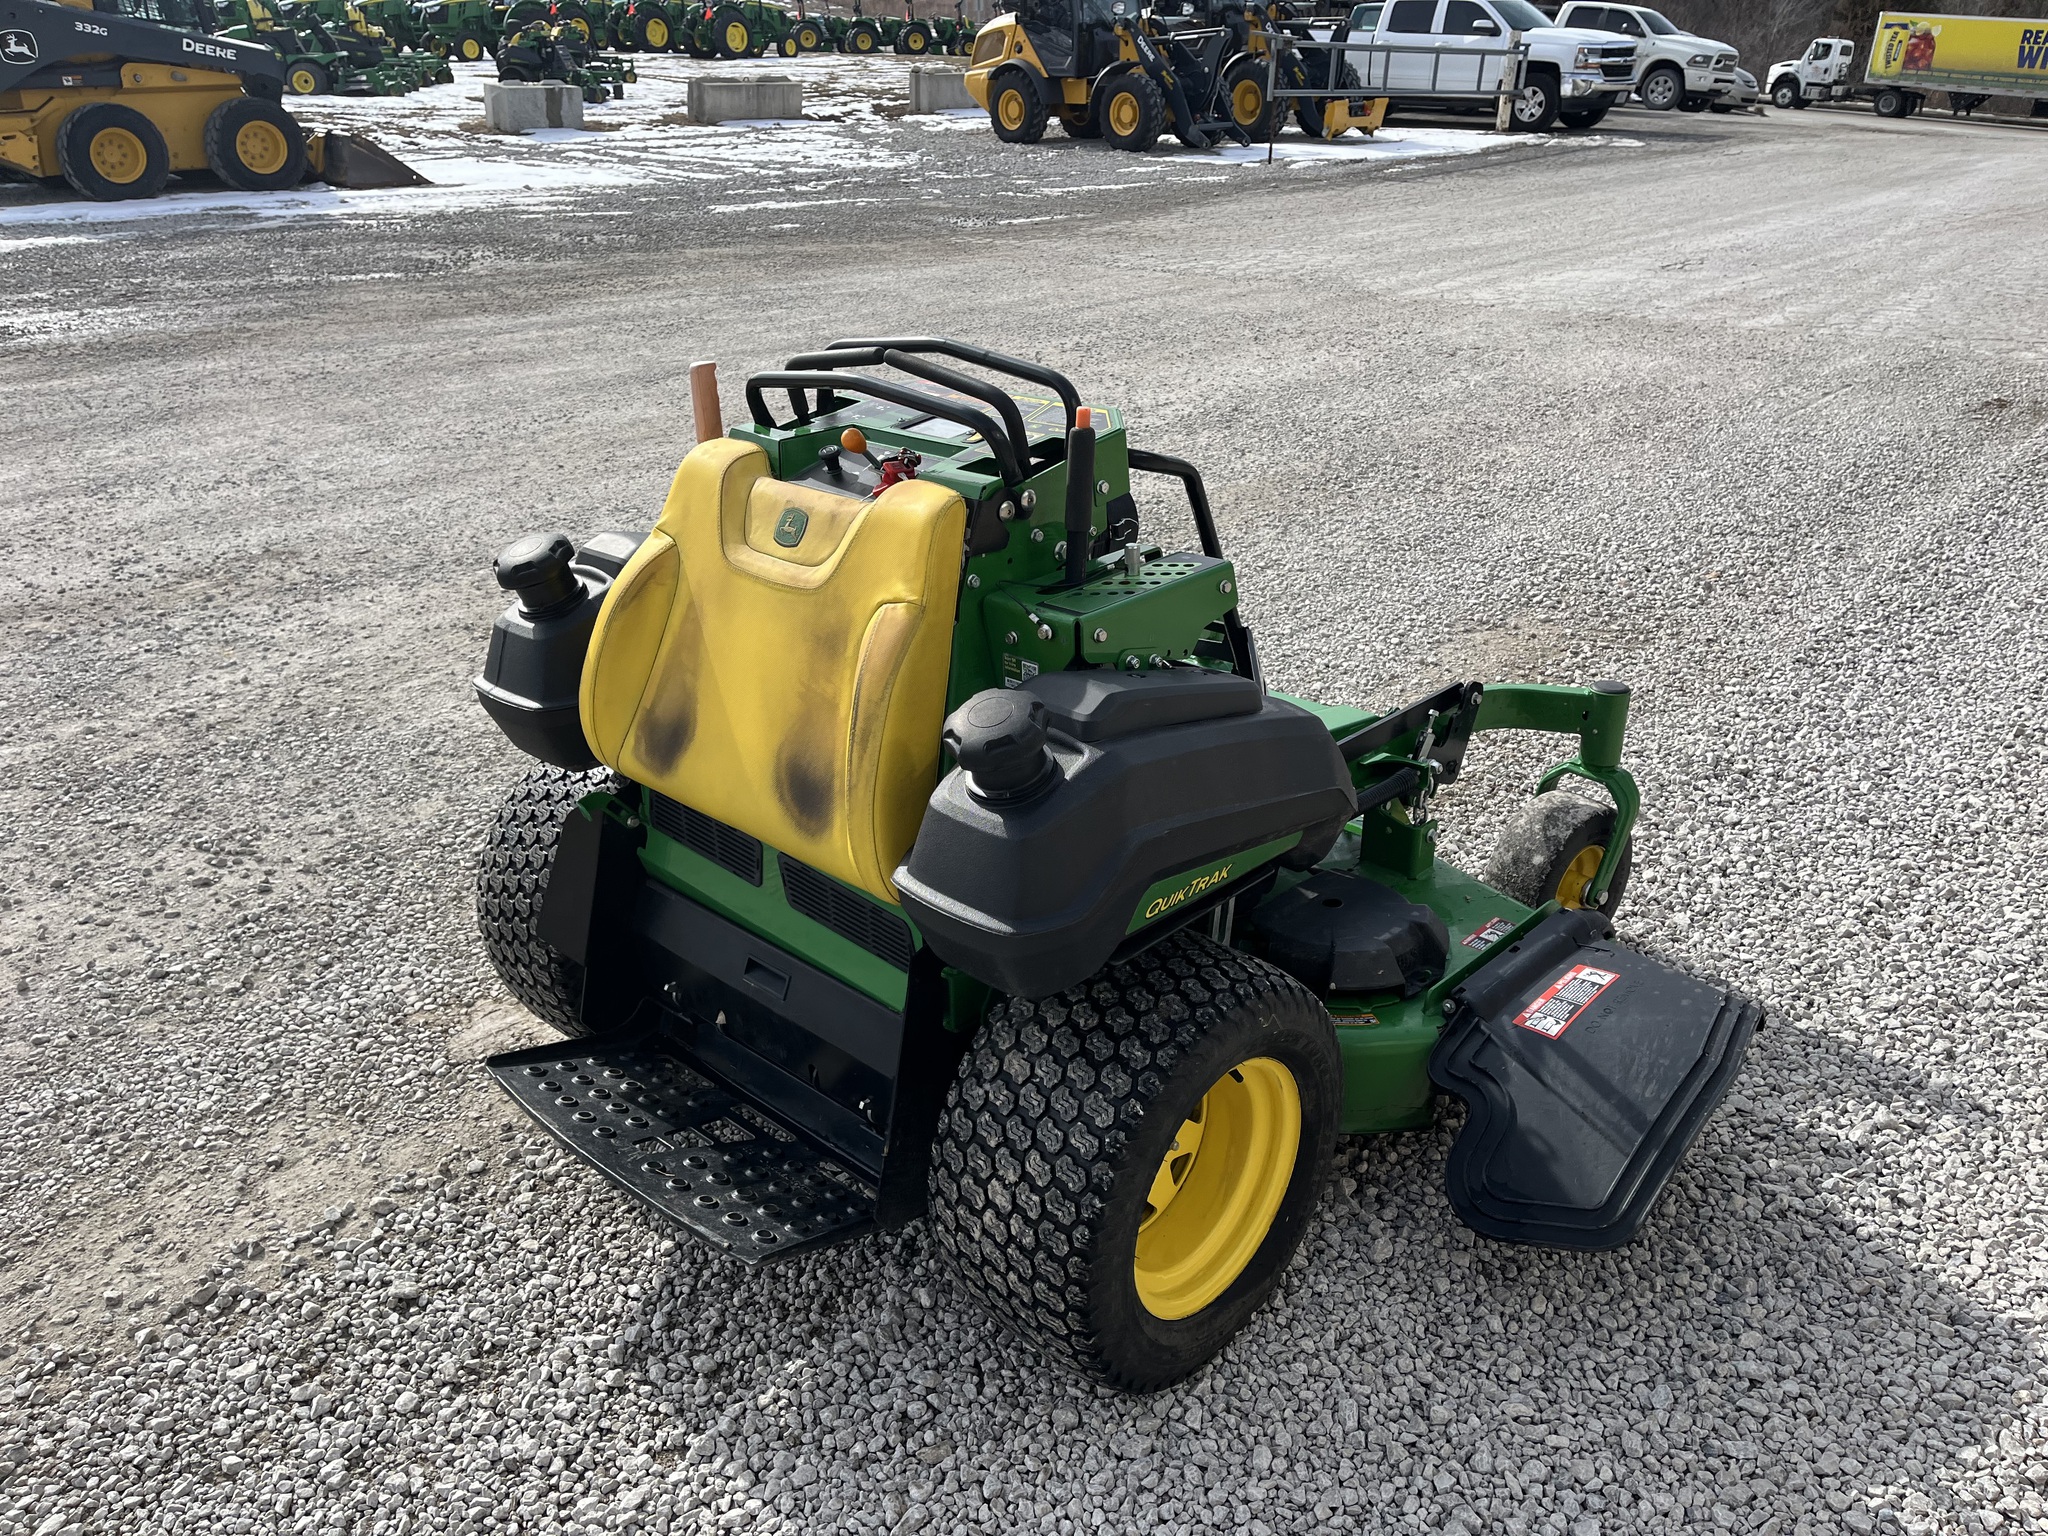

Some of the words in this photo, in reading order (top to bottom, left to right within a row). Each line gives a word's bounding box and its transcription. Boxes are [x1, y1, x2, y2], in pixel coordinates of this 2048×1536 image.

[75, 21, 108, 36] 332G
[182, 38, 237, 60] DEERE
[1137, 35, 1155, 62] DEERE
[1585, 1020, 1601, 1034] DO
